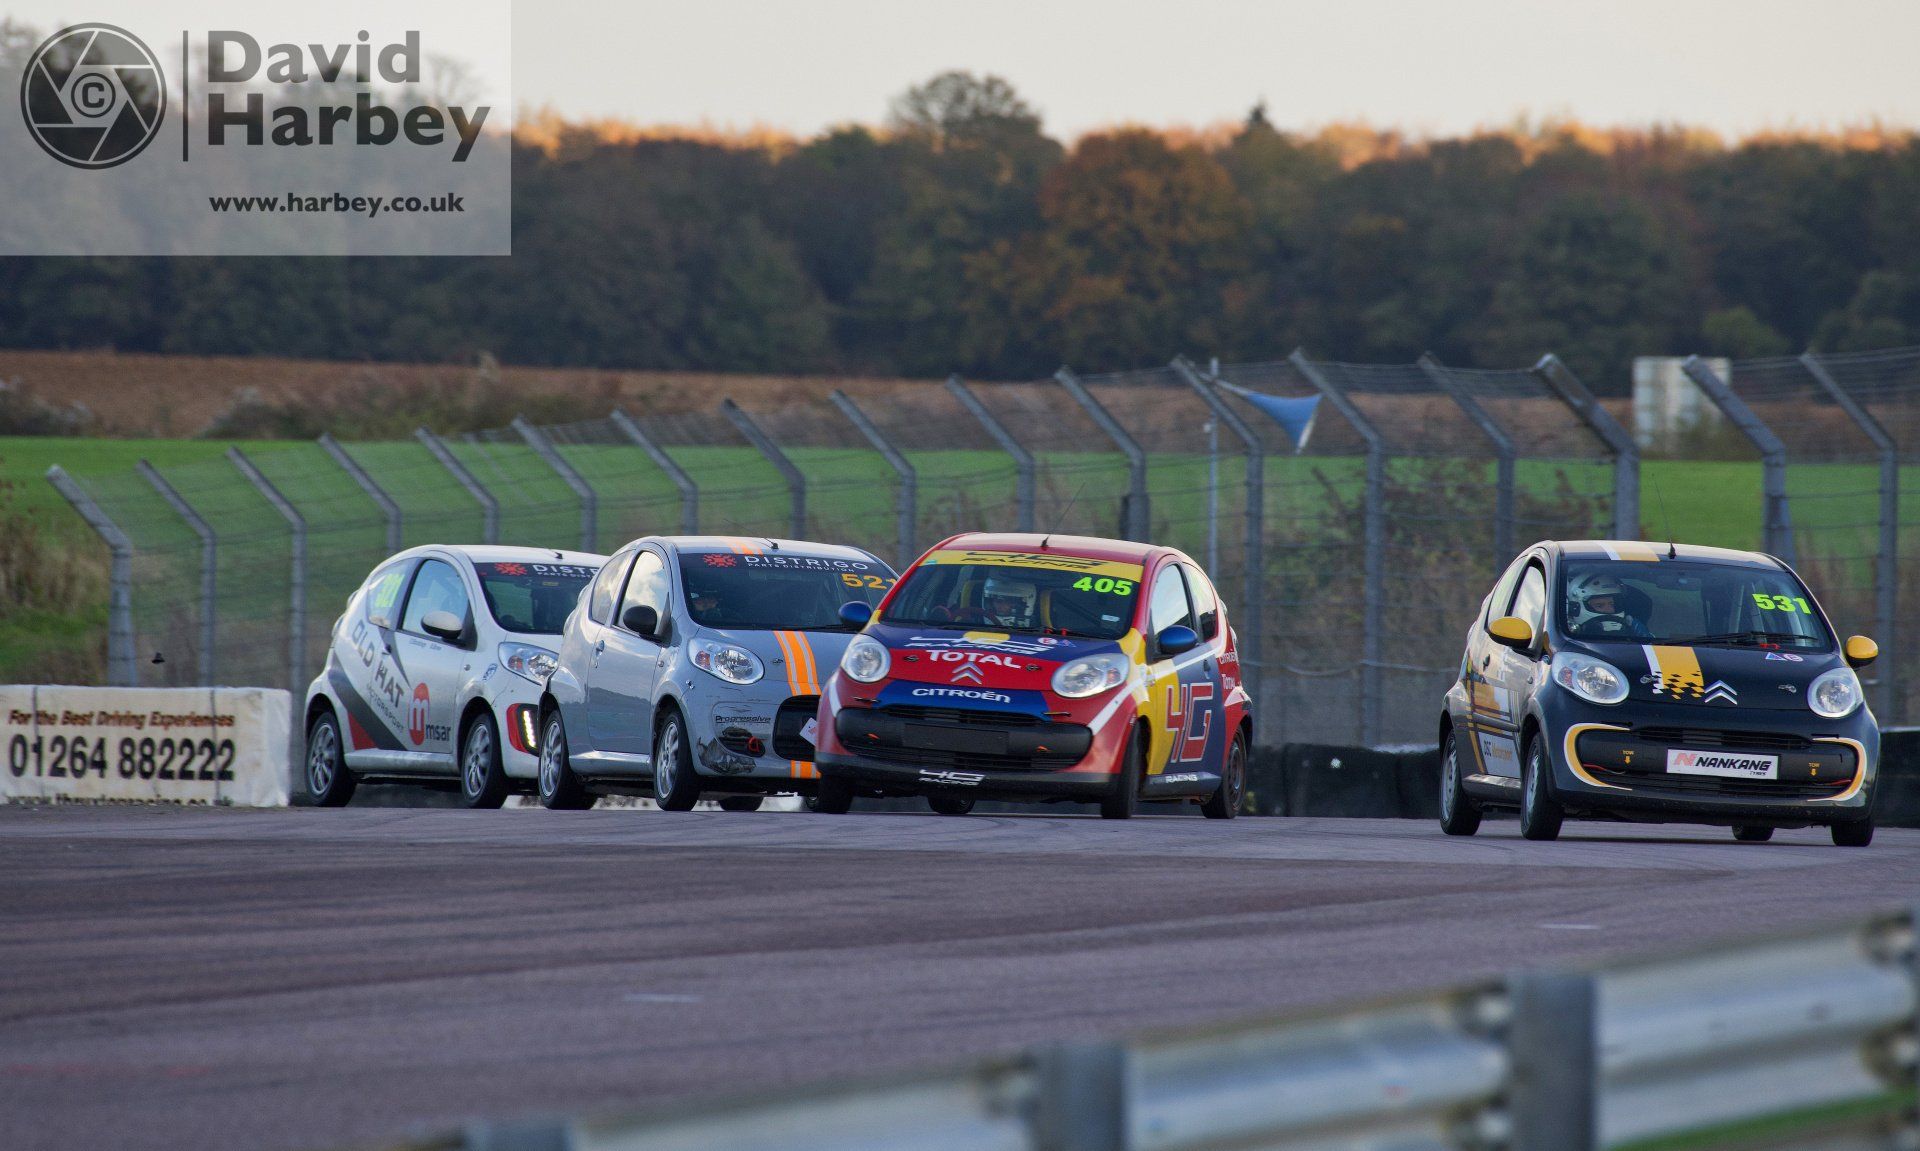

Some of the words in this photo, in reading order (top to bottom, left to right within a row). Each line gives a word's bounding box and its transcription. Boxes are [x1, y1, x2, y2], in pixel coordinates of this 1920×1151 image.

[744, 556, 869, 570] DISTRIGO
[1073, 576, 1133, 596] 405
[1752, 593, 1812, 615] 531
[904, 643, 1040, 655] RACING
[926, 649, 1022, 669] TOTAL
[352, 619, 375, 668] OLD
[375, 659, 404, 709] HAT
[8, 709, 33, 726] For
[36, 710, 58, 726] the
[60, 710, 95, 727] Best
[97, 711, 147, 730] Driving
[150, 711, 236, 731] Experiences
[715, 715, 771, 723] Progressive
[1165, 682, 1214, 763] 4G
[9, 733, 108, 779] 01264
[119, 737, 236, 781] 882222
[1695, 756, 1772, 772] NANKANG
